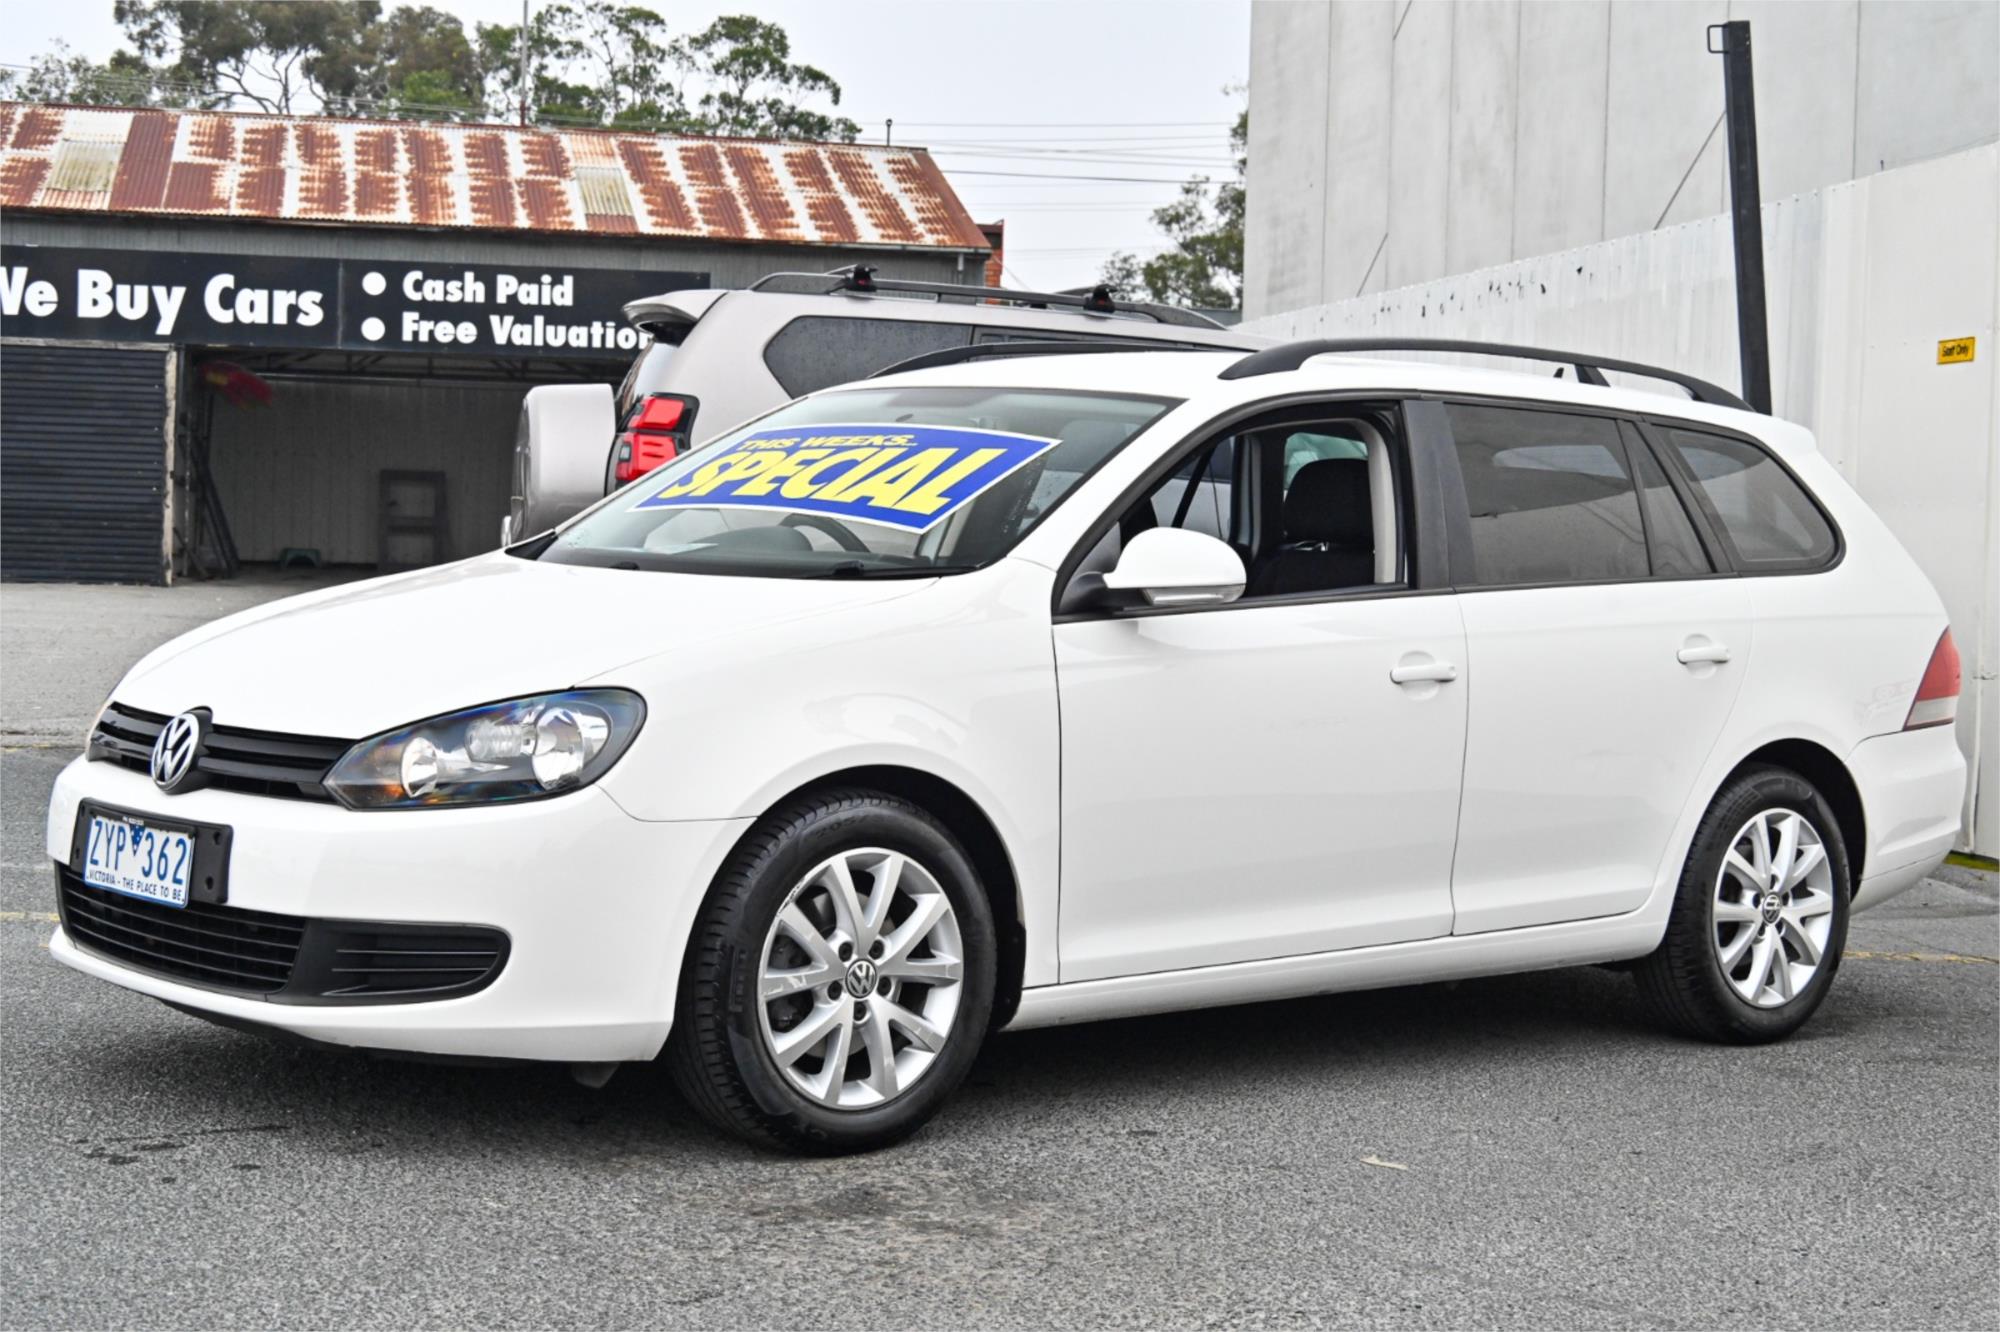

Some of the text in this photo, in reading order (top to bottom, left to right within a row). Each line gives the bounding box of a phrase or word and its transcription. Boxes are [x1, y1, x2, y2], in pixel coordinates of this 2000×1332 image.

[77, 268, 187, 336] Buy
[203, 273, 325, 327] Cars
[402, 270, 575, 307] Cash Paid
[402, 311, 478, 343] Free
[737, 438, 800, 450] THIS
[656, 447, 1010, 515] SPECIAL
[89, 819, 188, 886] ZYP 362
[89, 870, 117, 884] VICTORIA
[122, 877, 135, 891] THE
[136, 880, 158, 896] PLACE
[160, 885, 169, 898] TO
